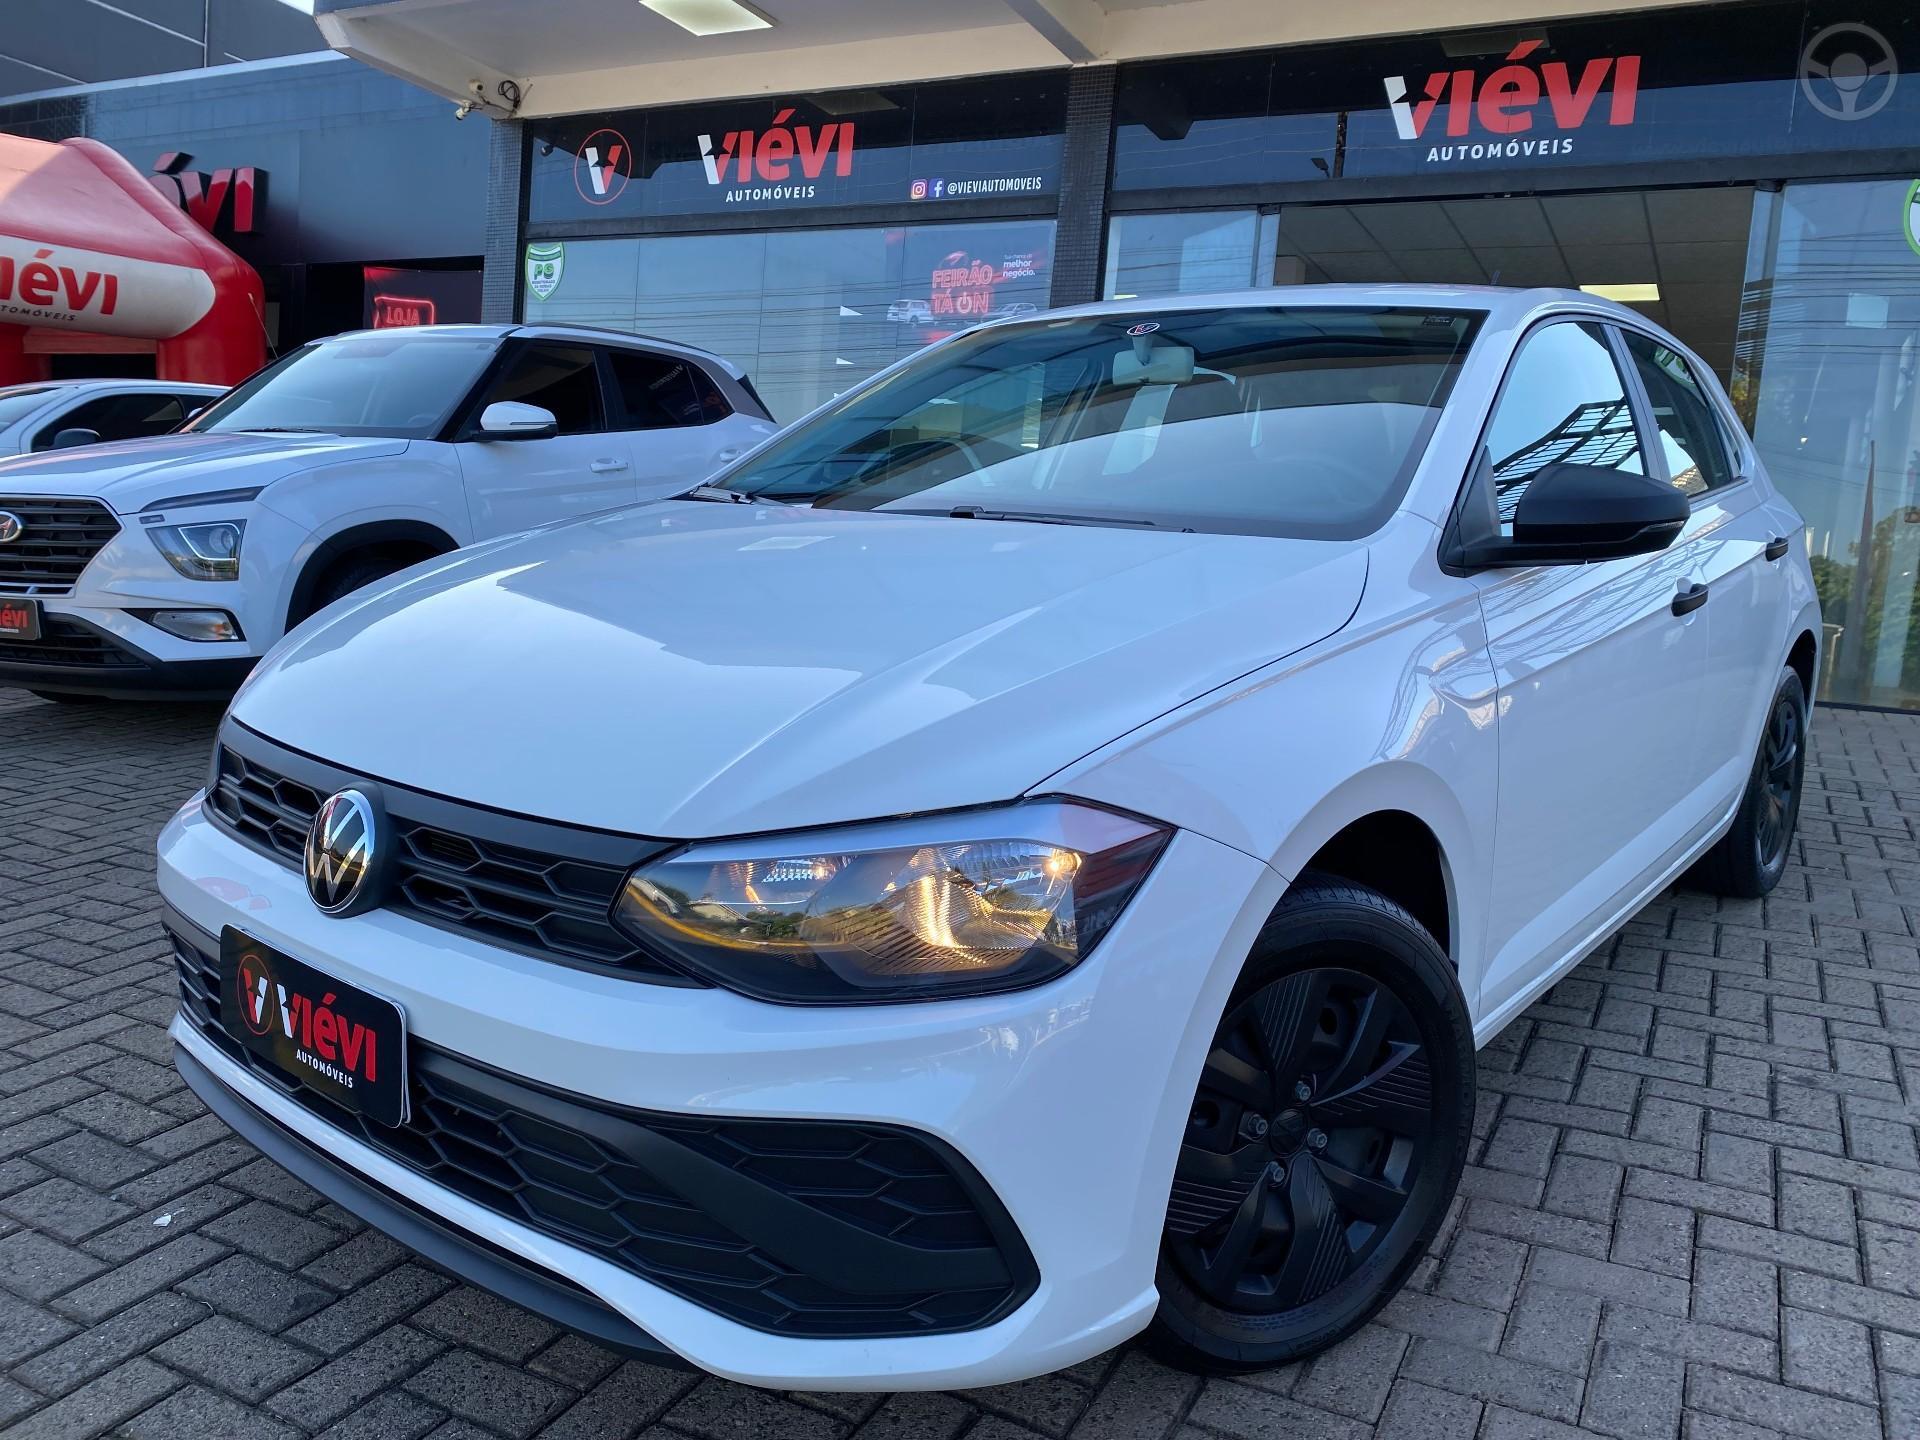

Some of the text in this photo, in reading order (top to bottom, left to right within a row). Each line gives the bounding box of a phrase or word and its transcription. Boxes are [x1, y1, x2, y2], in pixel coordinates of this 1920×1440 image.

[1427, 138, 1573, 162] AUTOMÓVEIS
[725, 184, 815, 203] AUTOMÓVEIS
[947, 176, 1042, 195] @VIEVIAUTOMOVEIS
[1003, 259, 1033, 268] melhor
[932, 260, 993, 289] FEIRÃO
[932, 288, 954, 314] TÁ
[0, 304, 77, 321] TOMÓVEIS
[386, 306, 419, 327] LOJA
[296, 1048, 353, 1089] AUTOMÓVEIS
